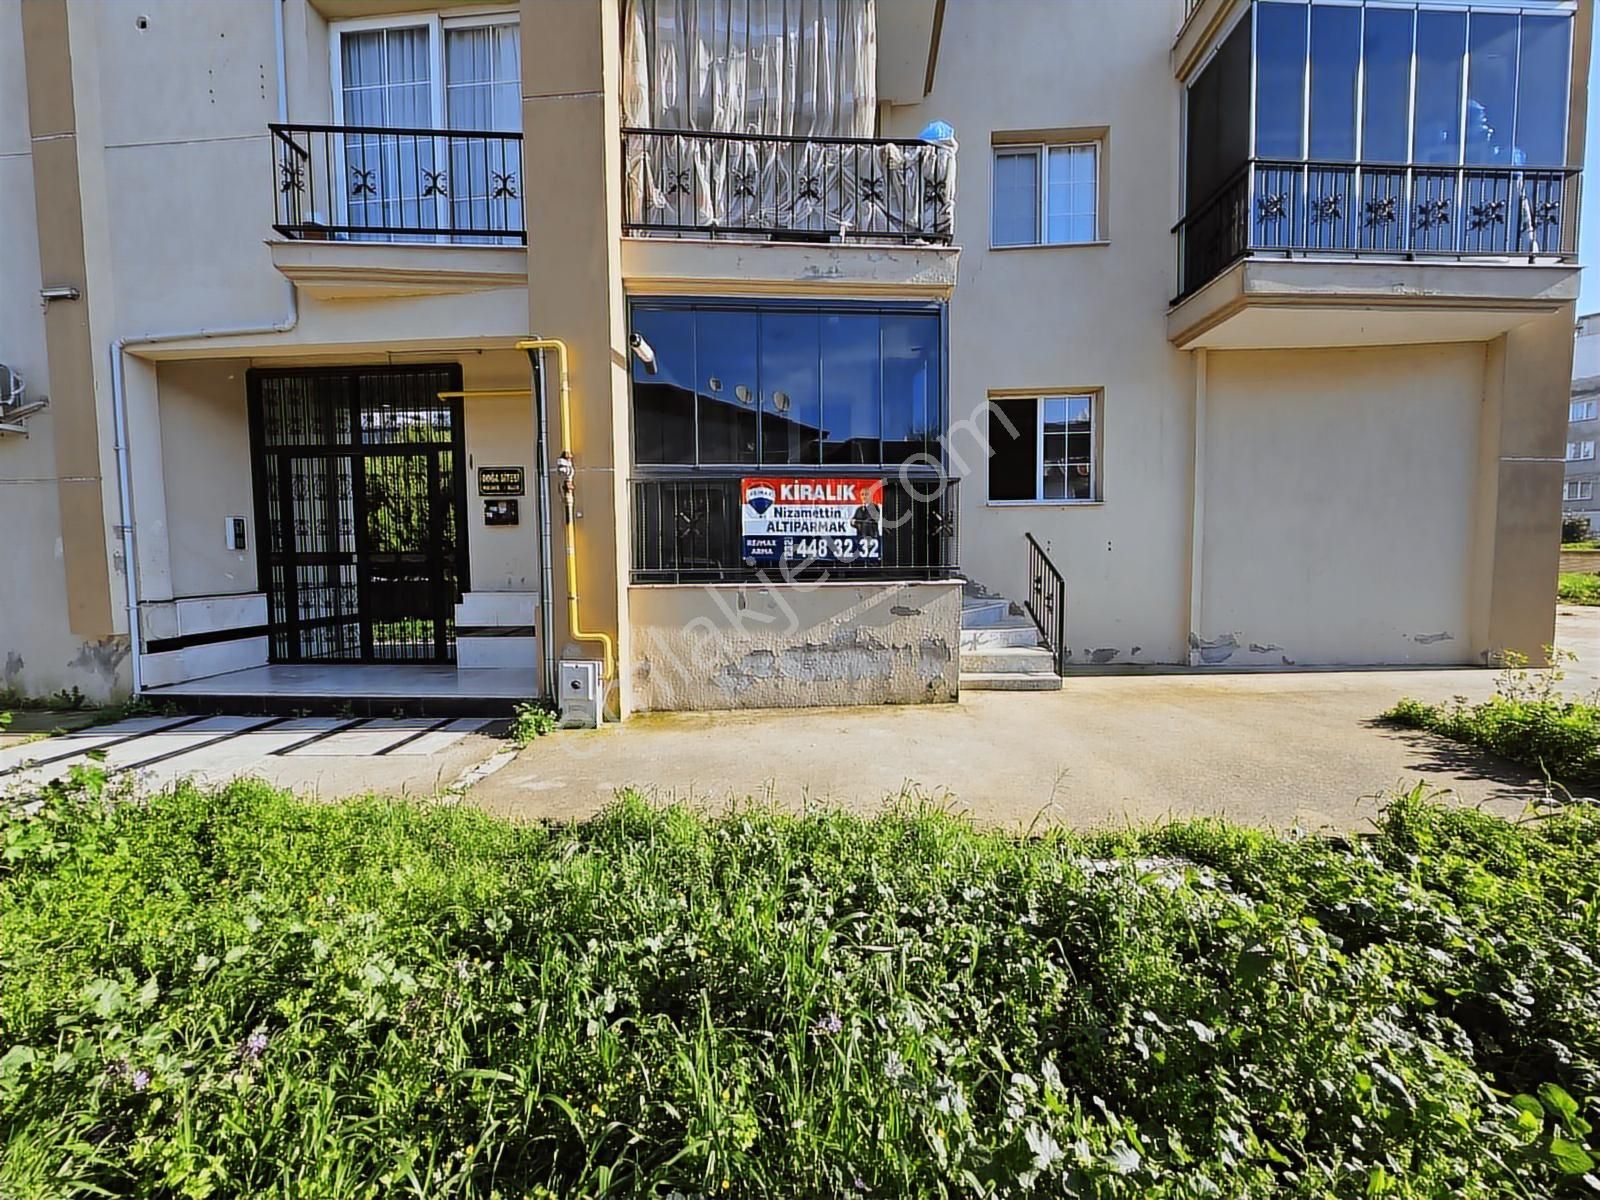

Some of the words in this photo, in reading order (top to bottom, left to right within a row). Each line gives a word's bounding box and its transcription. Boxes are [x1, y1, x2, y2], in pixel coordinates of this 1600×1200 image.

[780, 479, 856, 501] KİRALIK
[774, 507, 841, 518] Nizamettin
[766, 521, 846, 533] ALTIPARMAK
[796, 539, 828, 558] 448
[833, 539, 853, 558] 32
[859, 539, 879, 558] 32
